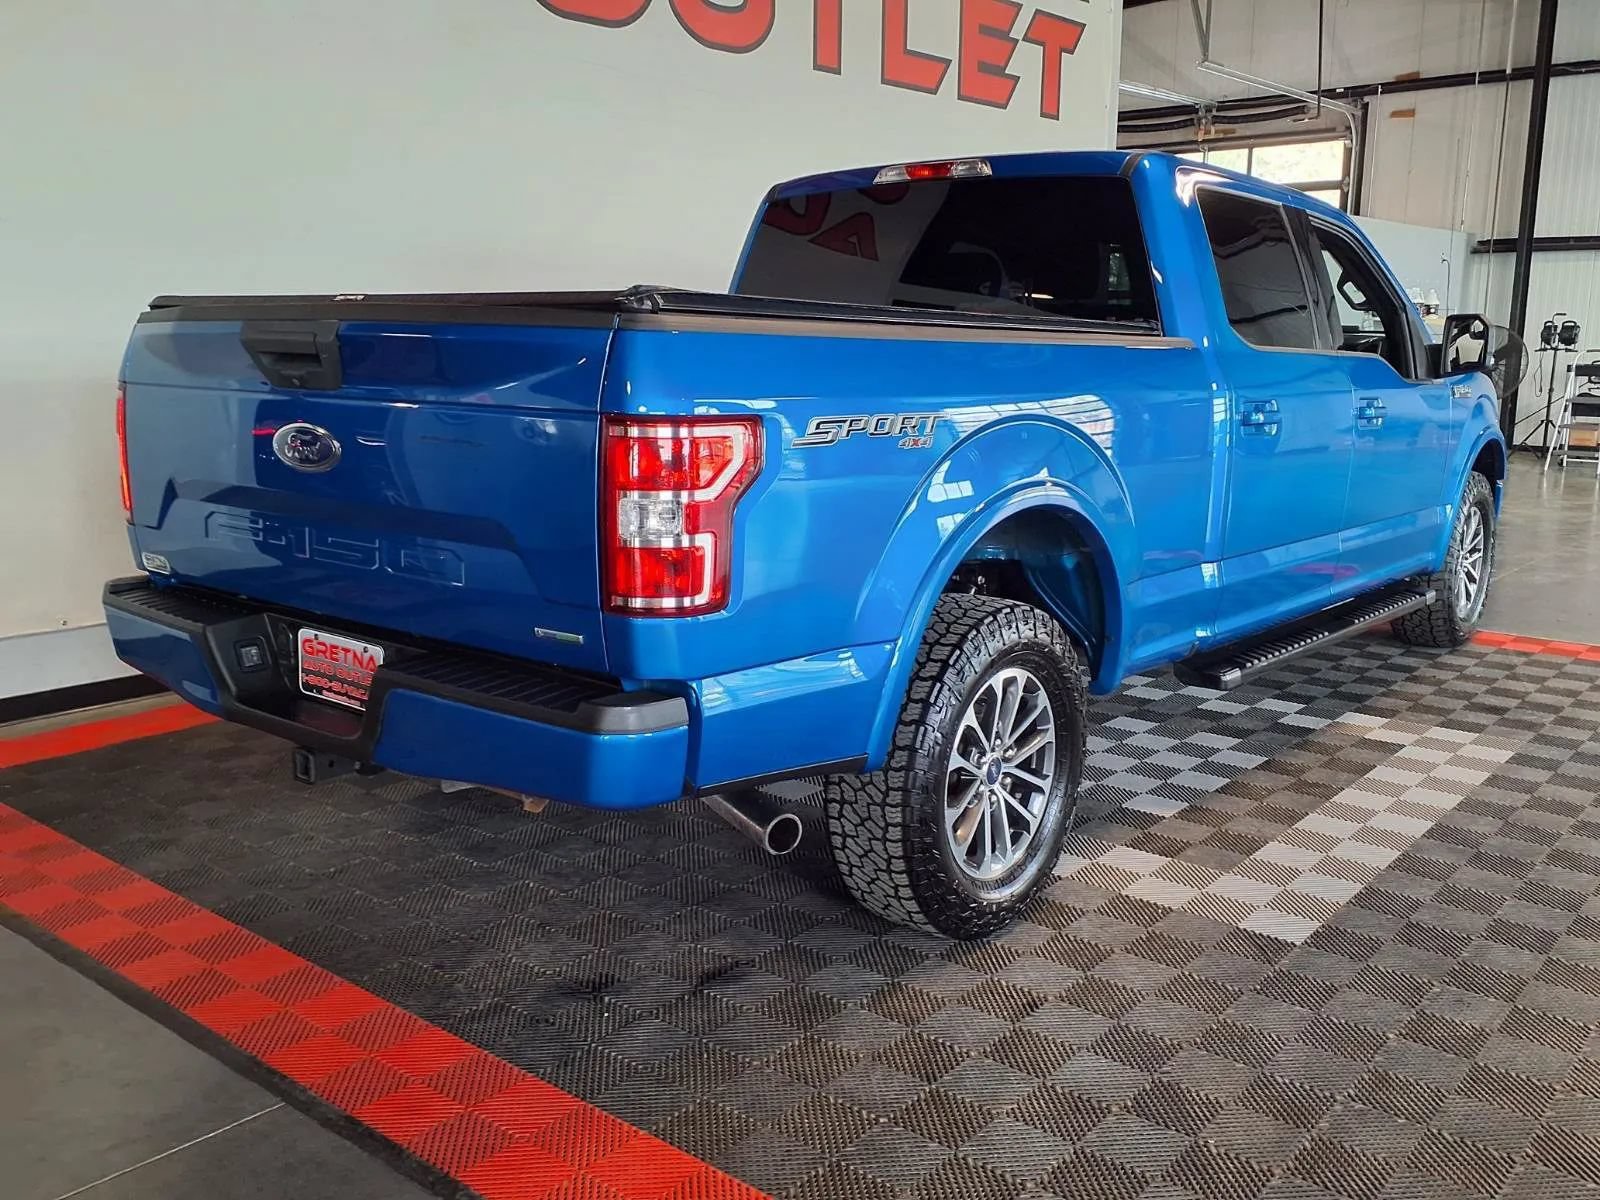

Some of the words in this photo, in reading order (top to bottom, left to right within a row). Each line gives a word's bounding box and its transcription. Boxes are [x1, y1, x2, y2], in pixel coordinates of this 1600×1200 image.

[534, 0, 1087, 121] LET
[791, 411, 950, 448] SPORT
[302, 639, 376, 673] GRETNA
